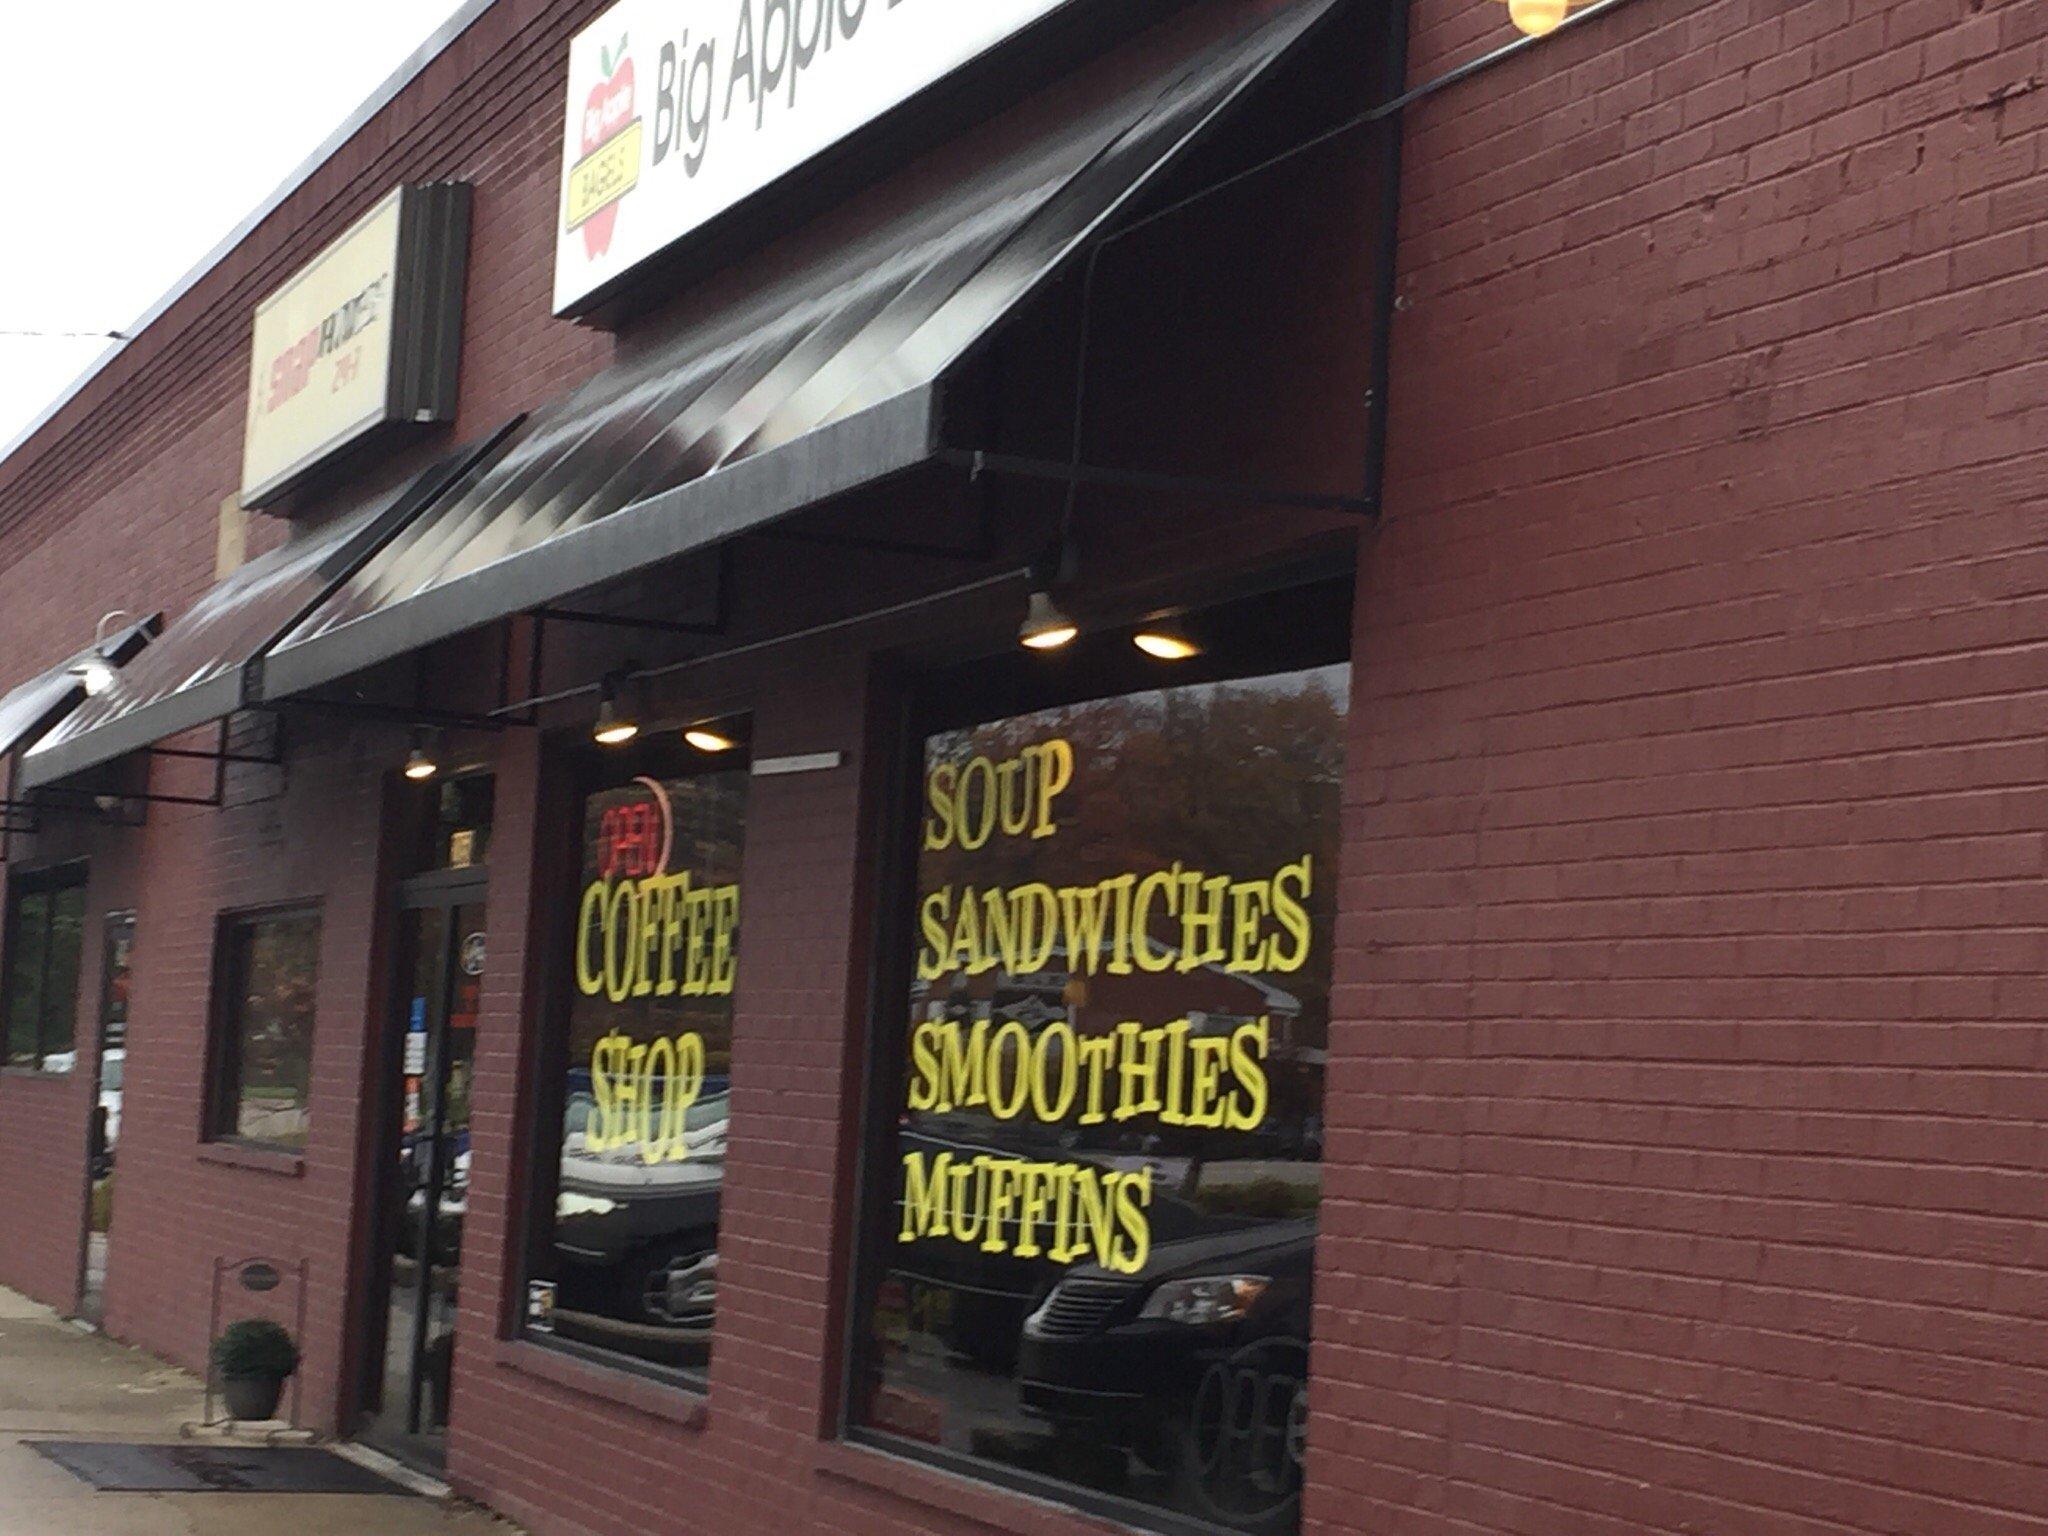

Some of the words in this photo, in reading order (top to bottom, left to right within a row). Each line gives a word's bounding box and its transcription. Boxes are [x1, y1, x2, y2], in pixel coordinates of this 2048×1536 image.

[652, 28, 715, 178] Big
[924, 739, 1073, 851] SOUP
[577, 870, 740, 1001] COFFEE
[918, 854, 1312, 980] SANDWICHES
[585, 1028, 705, 1165] SHOP
[908, 1016, 1268, 1131] SMOOTHIES
[899, 1151, 1151, 1274] MUFFINS
